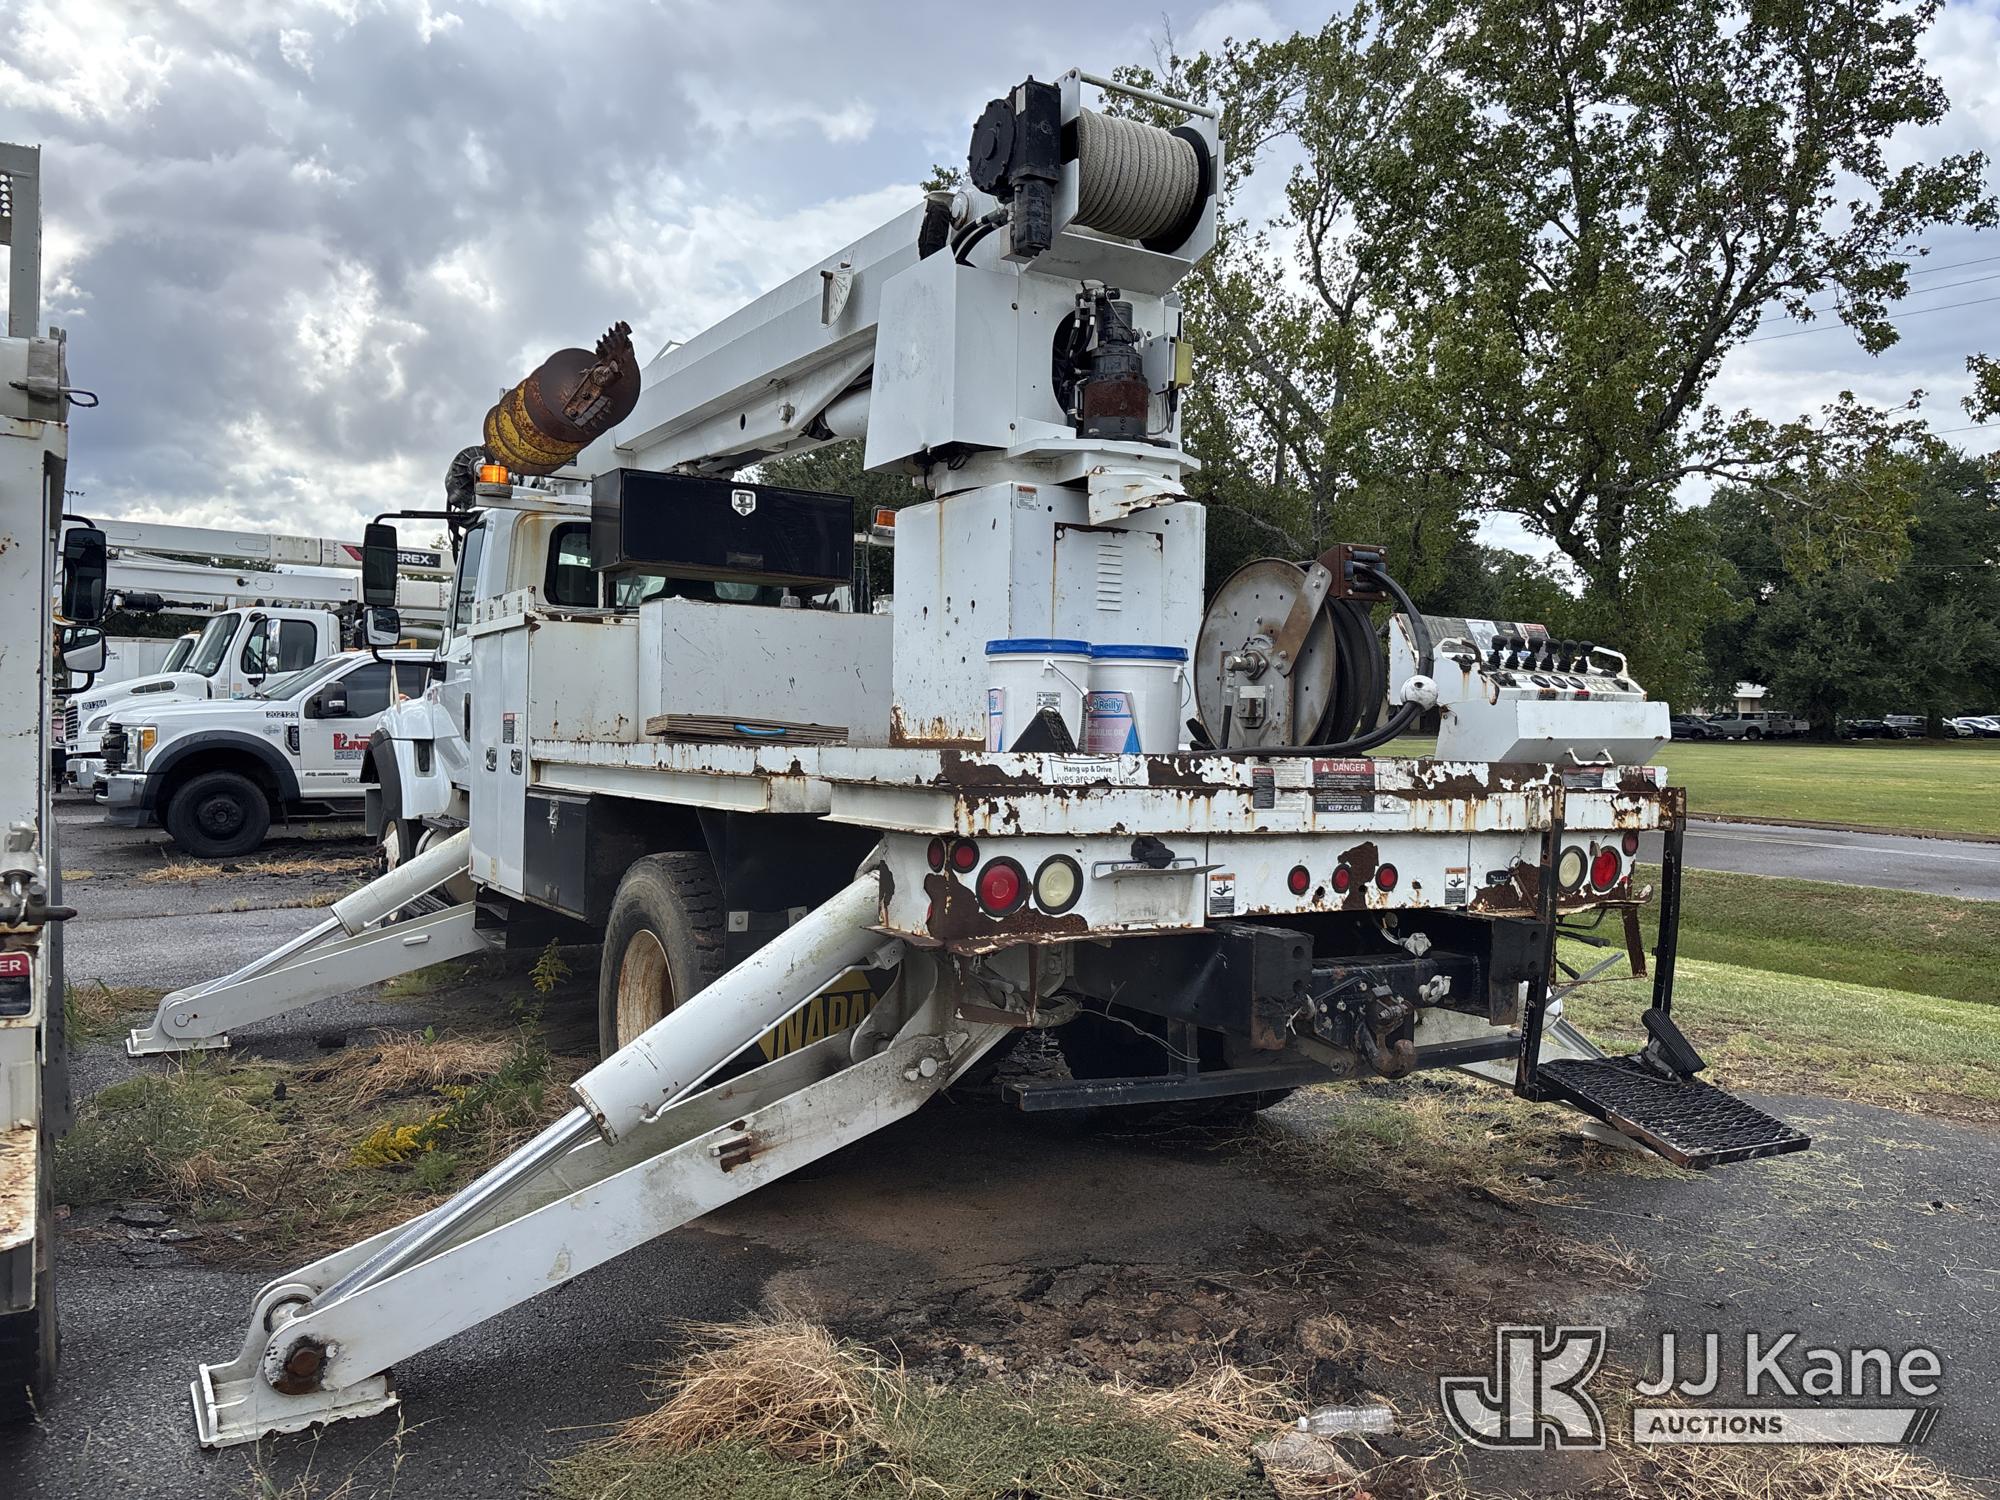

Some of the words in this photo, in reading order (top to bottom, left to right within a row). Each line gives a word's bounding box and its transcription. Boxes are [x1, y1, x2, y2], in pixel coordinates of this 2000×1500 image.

[397, 552, 429, 565] EREX
[1063, 765, 1080, 774] Hang
[1081, 766, 1089, 774] up
[1333, 763, 1366, 772] DANGER
[1104, 773, 1117, 784] he
[0, 960, 22, 972] ER
